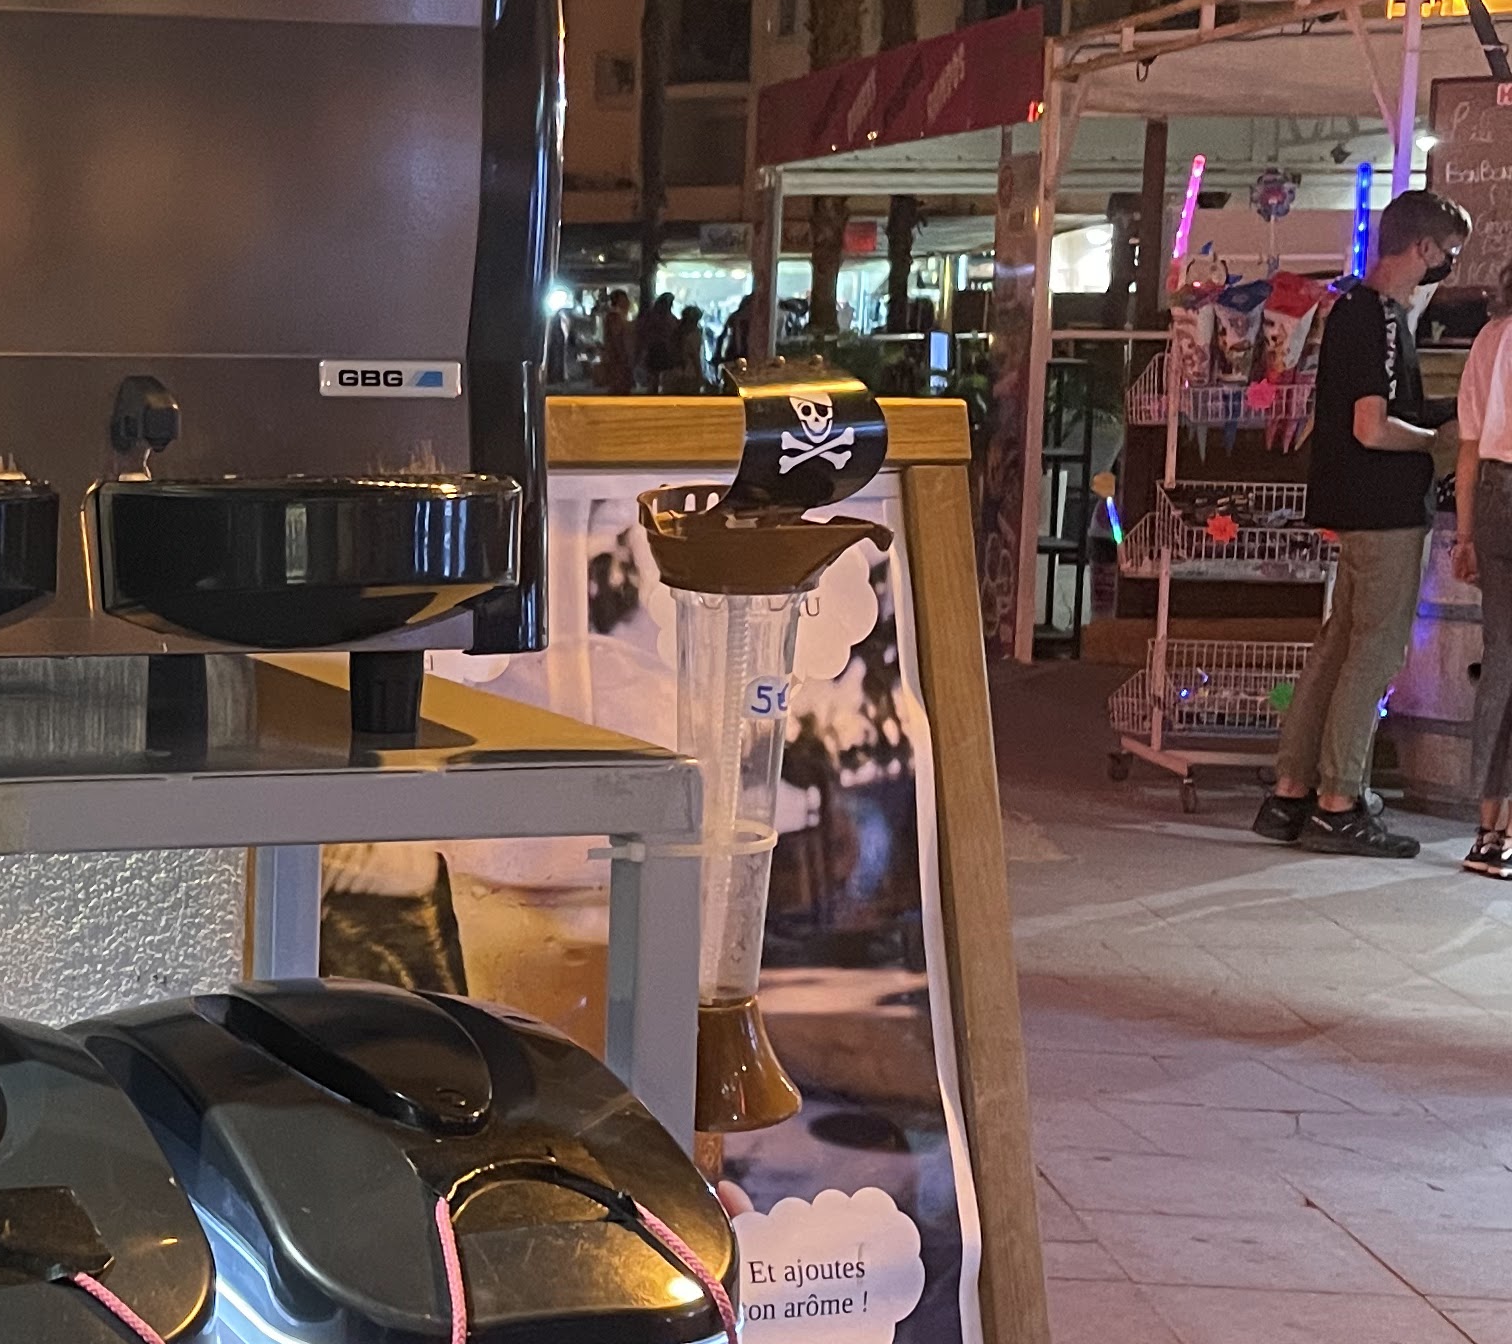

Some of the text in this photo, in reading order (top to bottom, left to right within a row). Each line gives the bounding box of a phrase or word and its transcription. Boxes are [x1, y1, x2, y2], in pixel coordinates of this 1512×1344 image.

[338, 369, 403, 387] GBG
[747, 1258, 866, 1288] Et ajoutes
[784, 1293, 854, 1318] arôme
